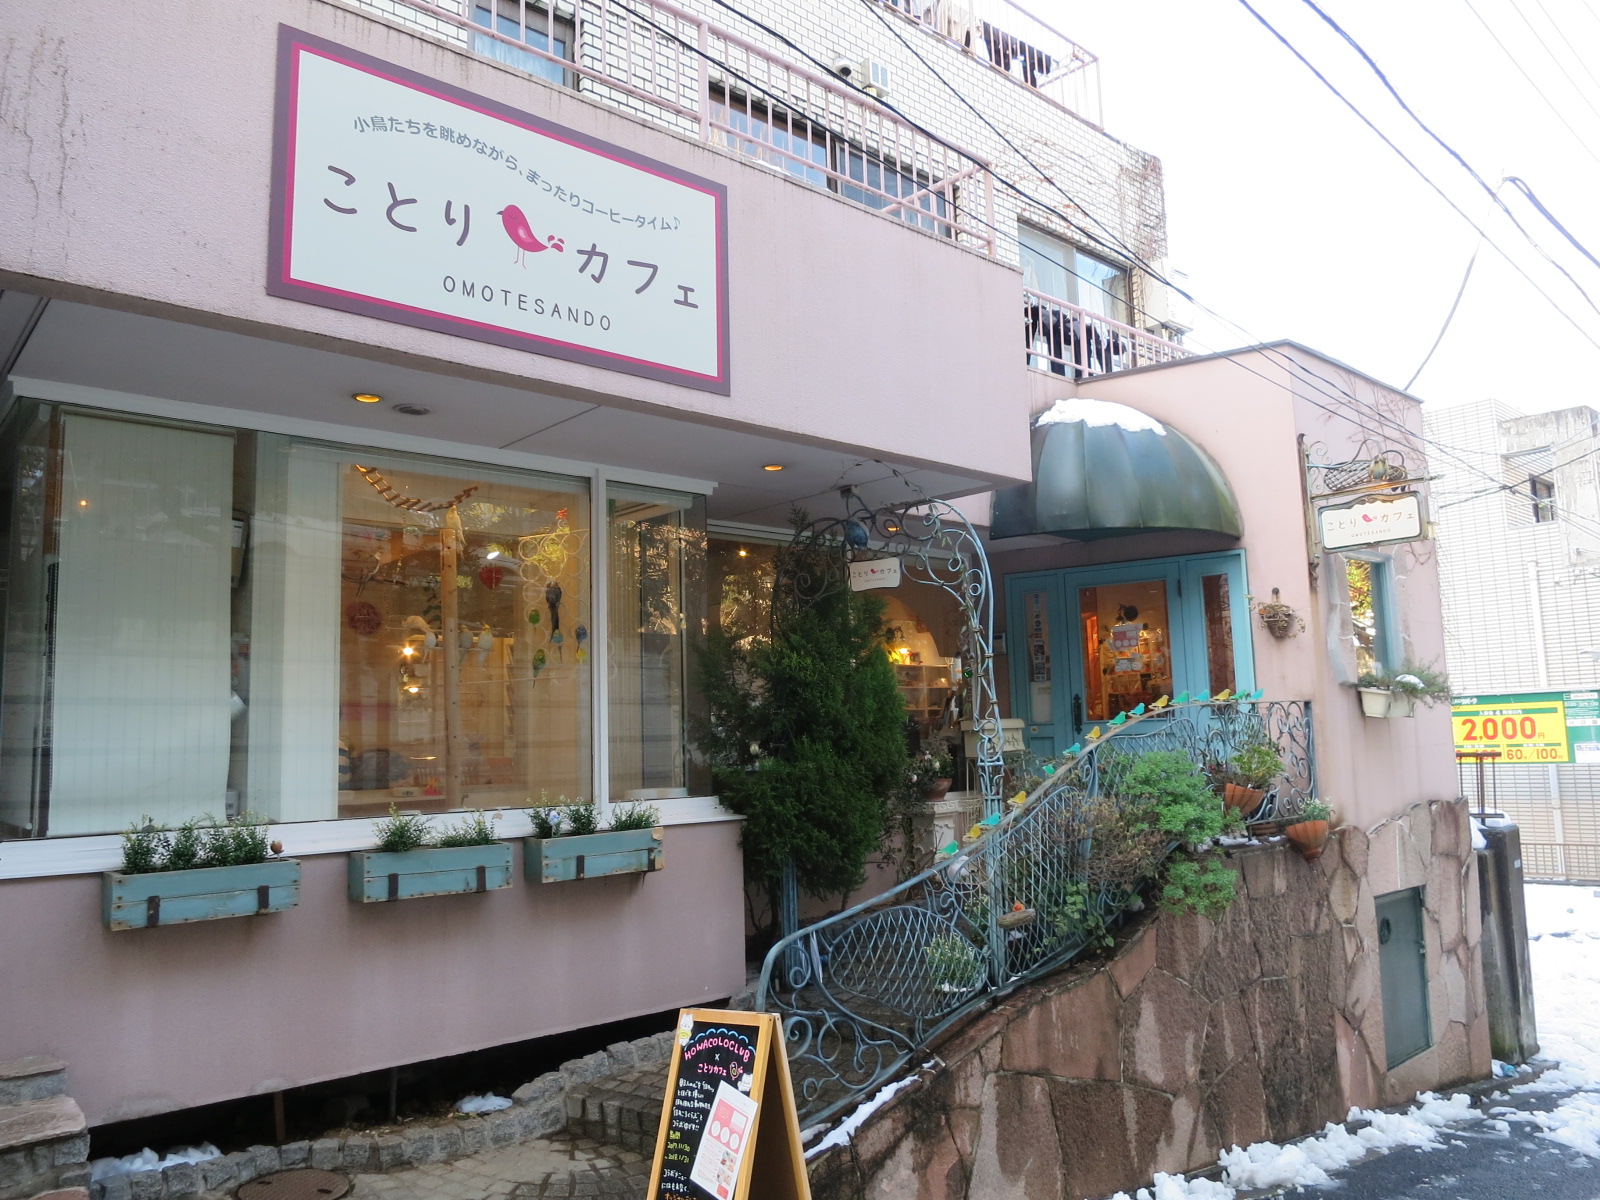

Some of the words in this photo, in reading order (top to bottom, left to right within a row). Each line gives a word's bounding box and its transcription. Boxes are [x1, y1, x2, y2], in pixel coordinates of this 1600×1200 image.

[323, 165, 470, 246] ことり
[576, 243, 699, 309] カフェ
[442, 275, 612, 332] OMOTESANDO
[1327, 518, 1357, 531] ことり
[1380, 512, 1415, 522] カフェ
[684, 1036, 750, 1062] HOWACOLOCLUB
[697, 1062, 727, 1076] ことりカフェ
